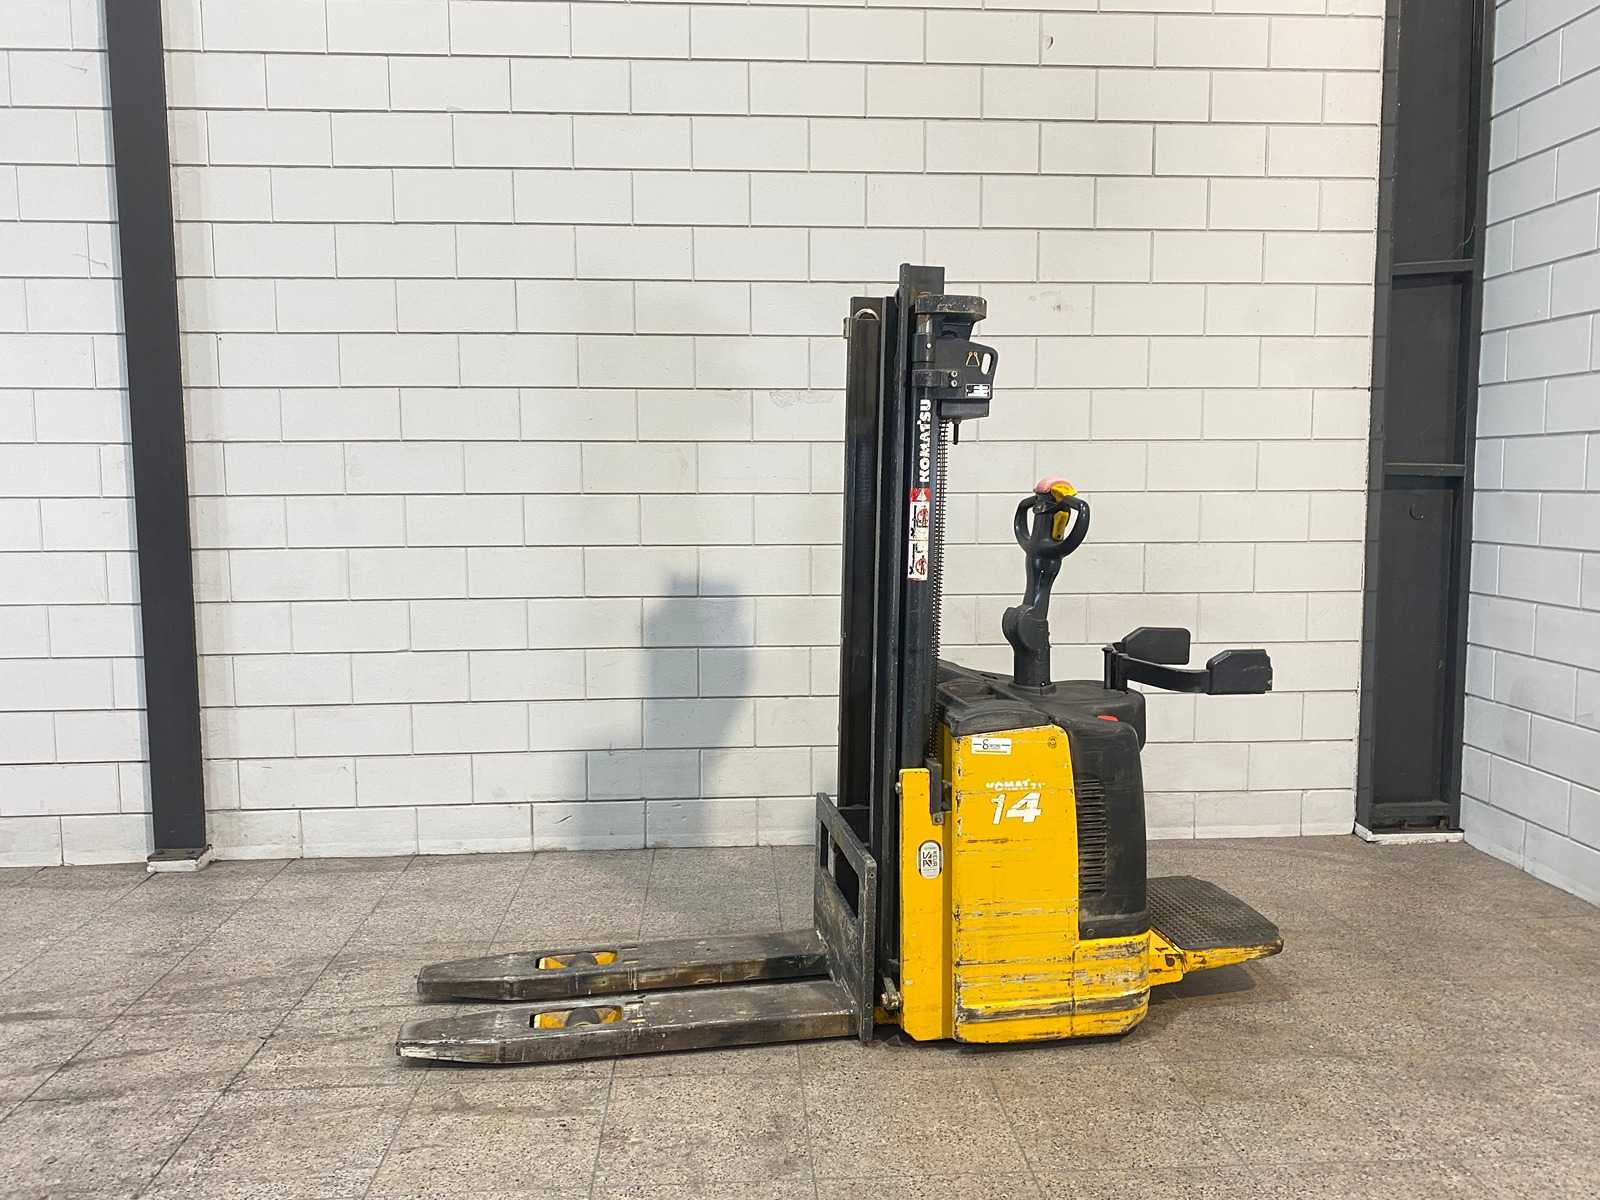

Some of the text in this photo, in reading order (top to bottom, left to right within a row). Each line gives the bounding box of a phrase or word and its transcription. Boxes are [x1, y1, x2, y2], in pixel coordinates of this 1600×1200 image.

[917, 399, 931, 482] KOMATSU
[985, 779, 1045, 791] OMAT
[991, 792, 1041, 825] 14
